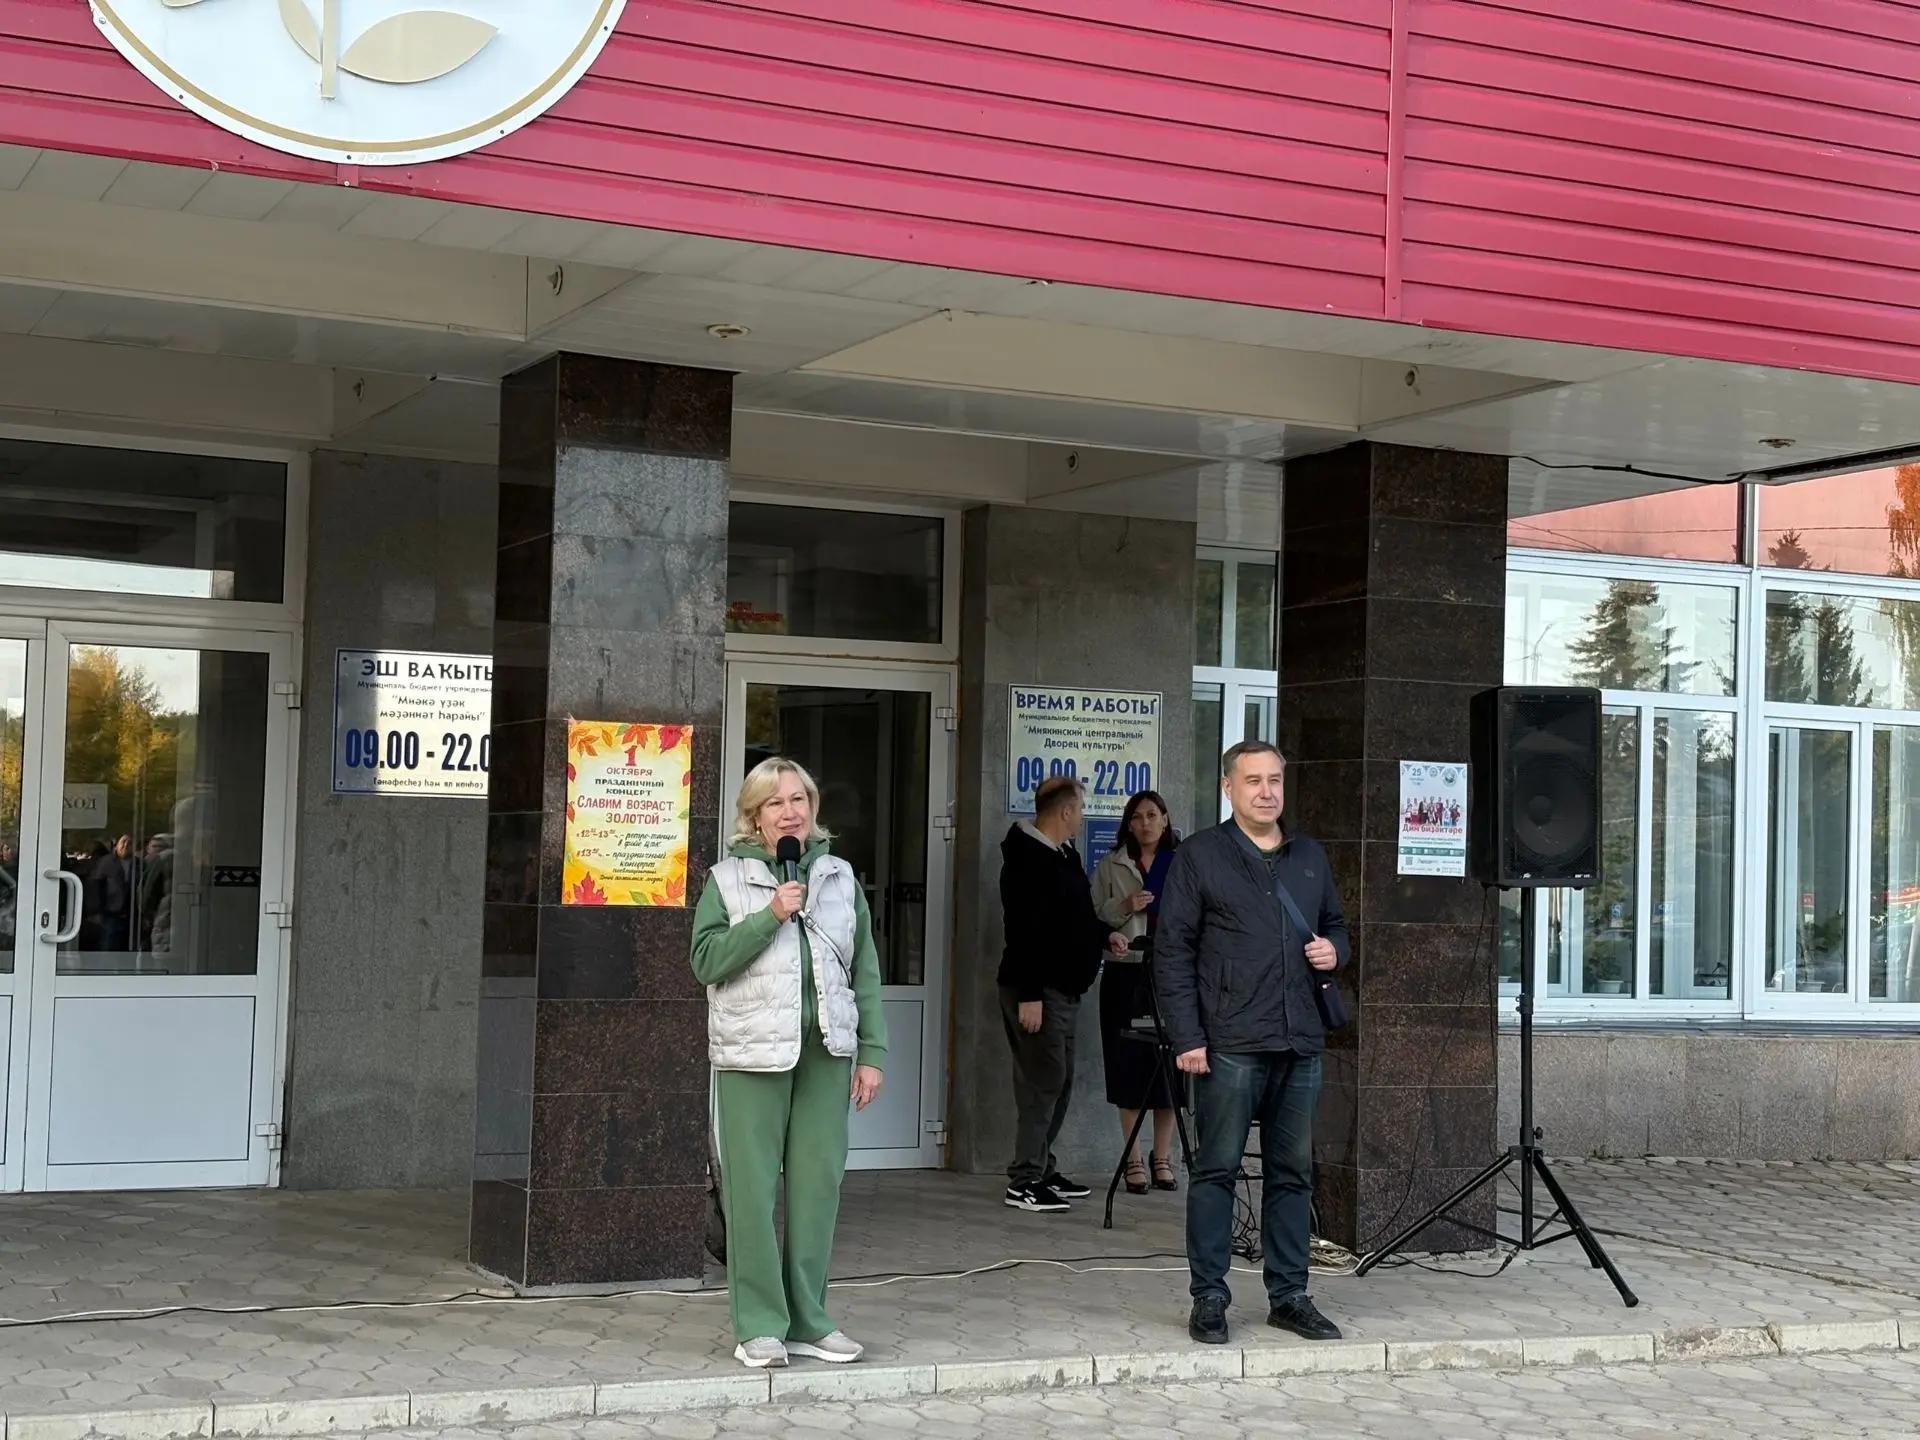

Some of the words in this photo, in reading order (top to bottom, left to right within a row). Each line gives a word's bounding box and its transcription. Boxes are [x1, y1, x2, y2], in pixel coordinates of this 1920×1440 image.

[361, 659, 398, 677] ЭШ
[409, 682, 442, 691] бюджет
[1016, 693, 1075, 711] ВРЕМЯ
[1082, 696, 1155, 715] РАБОТЫ
[1018, 713, 1070, 722] Муниципальное
[1072, 714, 1110, 724] бюджетное
[1112, 719, 1152, 727] учреждение
[1085, 728, 1143, 740] центральный
[345, 728, 420, 770] 09.00
[1044, 738, 1078, 750] Дворец
[624, 745, 638, 767] 1
[606, 767, 653, 777] ОКТЯБРЯ
[1412, 767, 1422, 776] 25
[595, 778, 665, 789] ПРАЗДНИЧНЫЙ
[1093, 760, 1151, 796] 22.00
[606, 788, 652, 798] КОНЦЕРТ
[627, 800, 675, 812] ВОЗРАСТ
